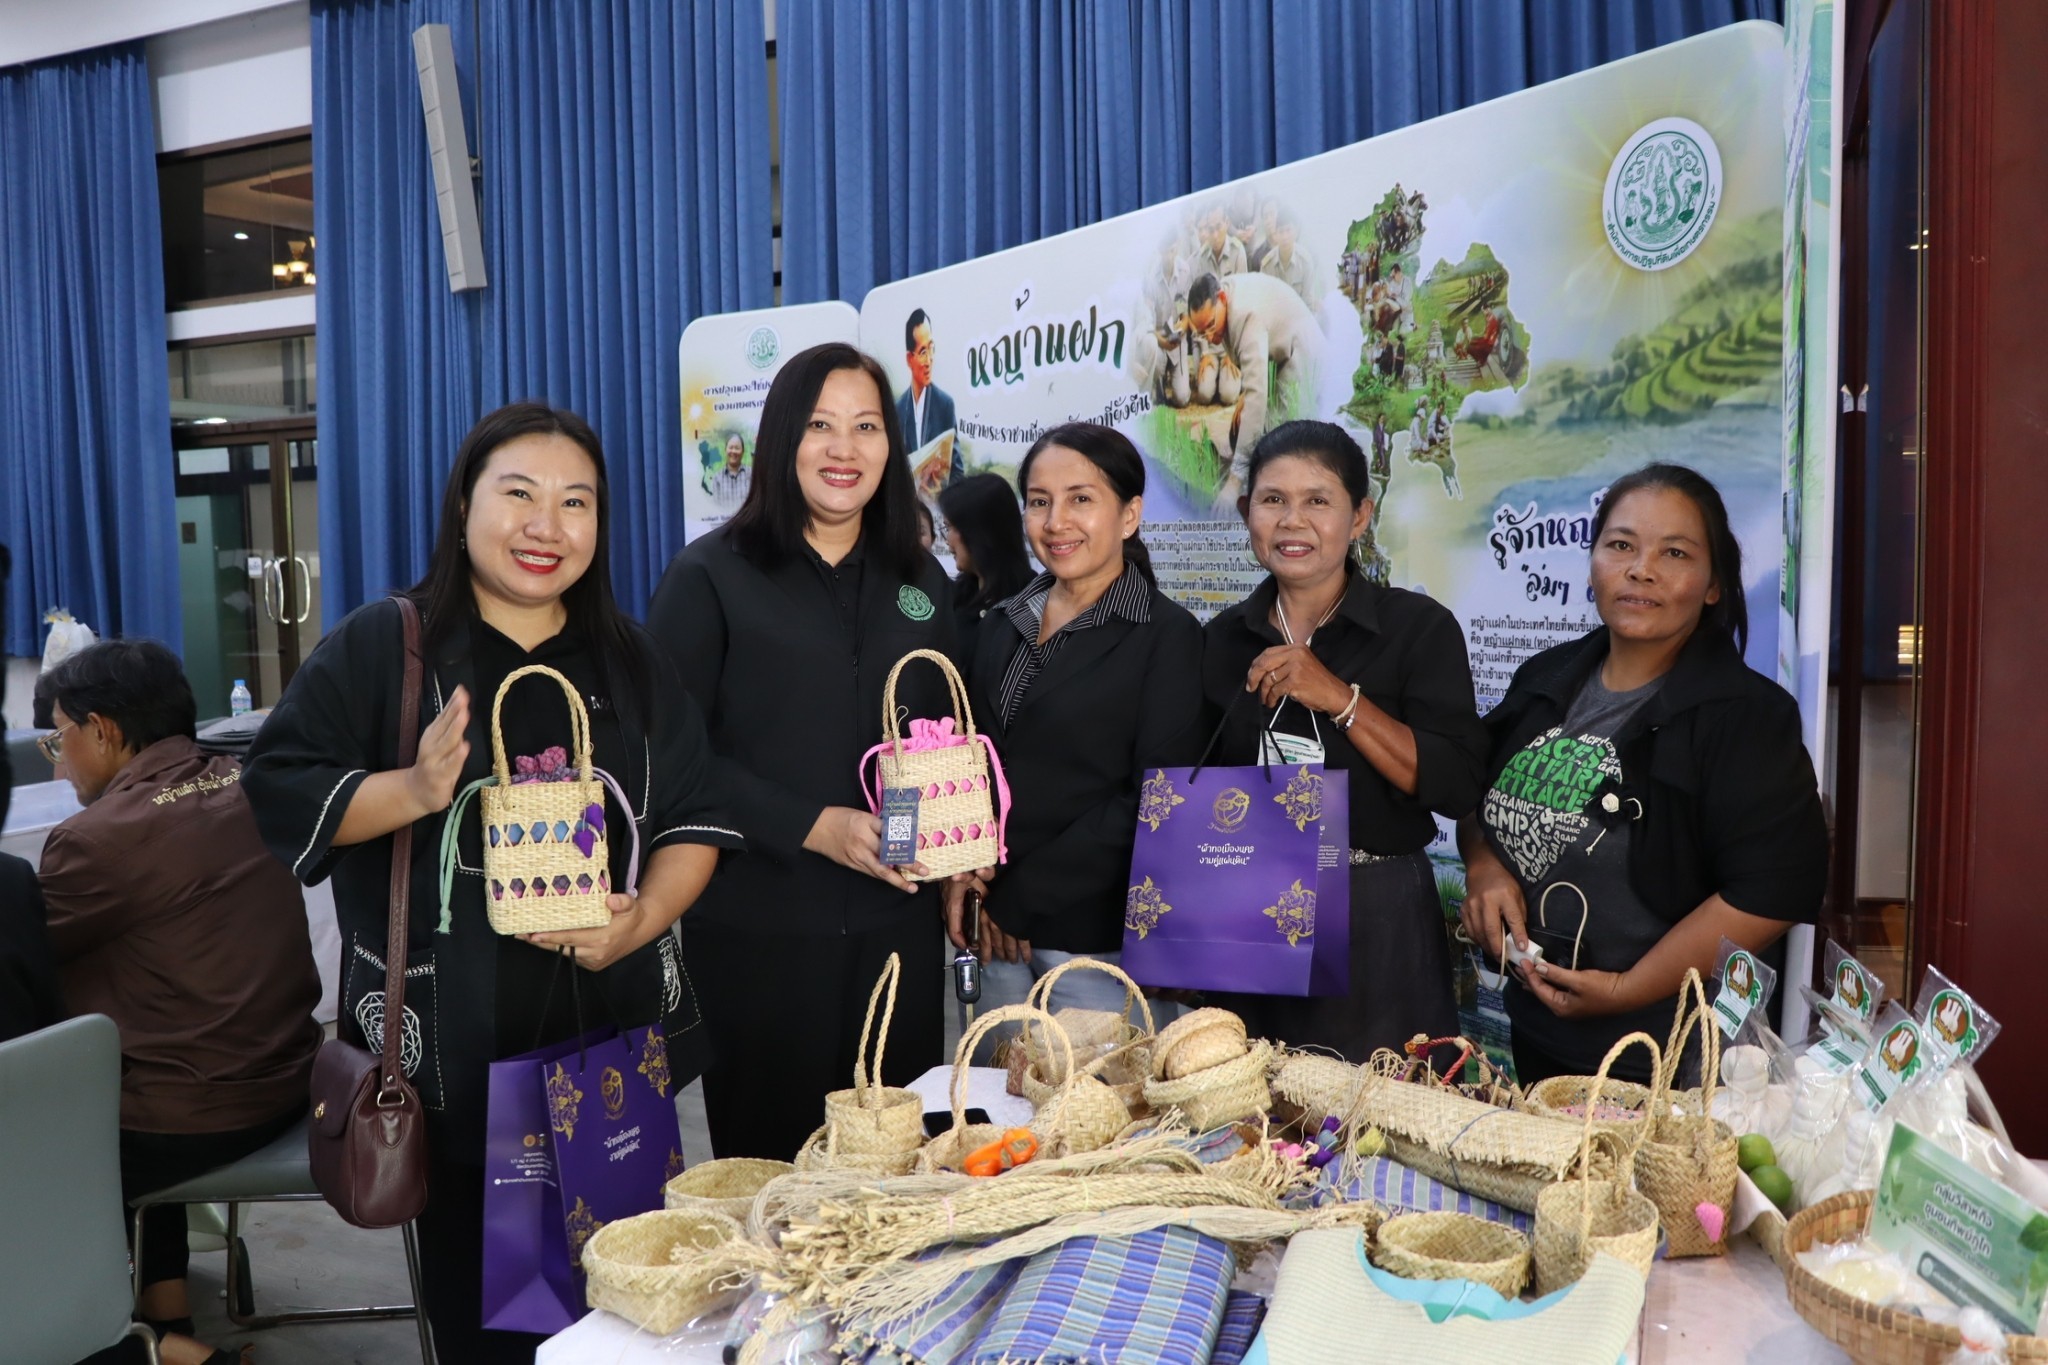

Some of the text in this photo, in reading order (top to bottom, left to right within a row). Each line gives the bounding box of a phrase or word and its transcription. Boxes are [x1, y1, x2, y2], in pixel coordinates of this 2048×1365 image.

[1607, 201, 1716, 269] สำนักงานการปฏิรูปที่ดินเพื่อเกษตรกรรม
[966, 288, 1126, 389] หญ้าแฝก
[1470, 632, 1481, 645] คือ
[1483, 633, 1532, 651] หญ้าแฝกลุ่ม
[152, 782, 198, 805] หญ้าแฝก
[1487, 788, 1535, 816] ORGANIC
[1484, 802, 1529, 836] GMP
[1555, 811, 1590, 829] ACFS
[1495, 830, 1522, 850] GAP
[1560, 833, 1577, 844] GAP
